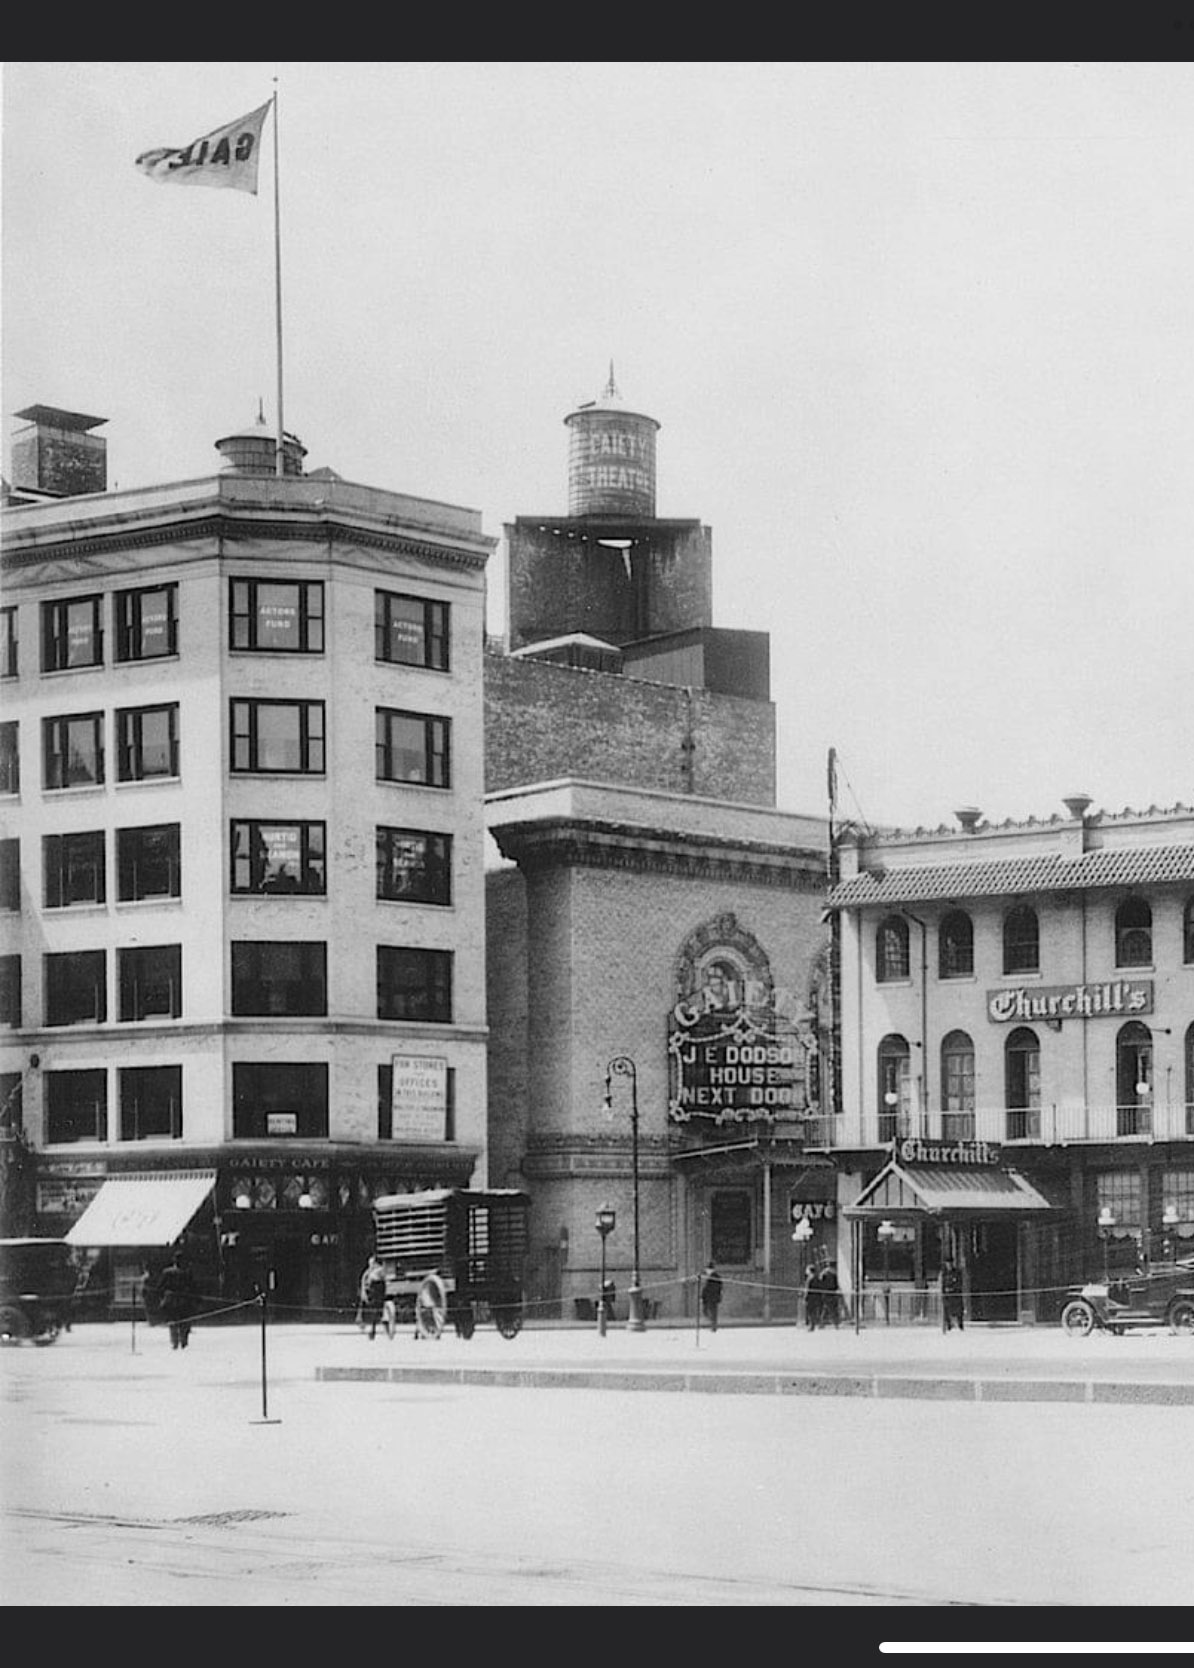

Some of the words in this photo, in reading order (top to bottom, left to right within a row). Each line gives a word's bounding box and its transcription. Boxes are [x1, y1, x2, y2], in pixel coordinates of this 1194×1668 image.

[990, 985, 1147, 1021] Churchill's
[683, 1046, 697, 1064] J
[705, 1046, 718, 1063] E
[710, 1066, 781, 1084] HOUSE
[682, 1086, 737, 1105] NEXT
